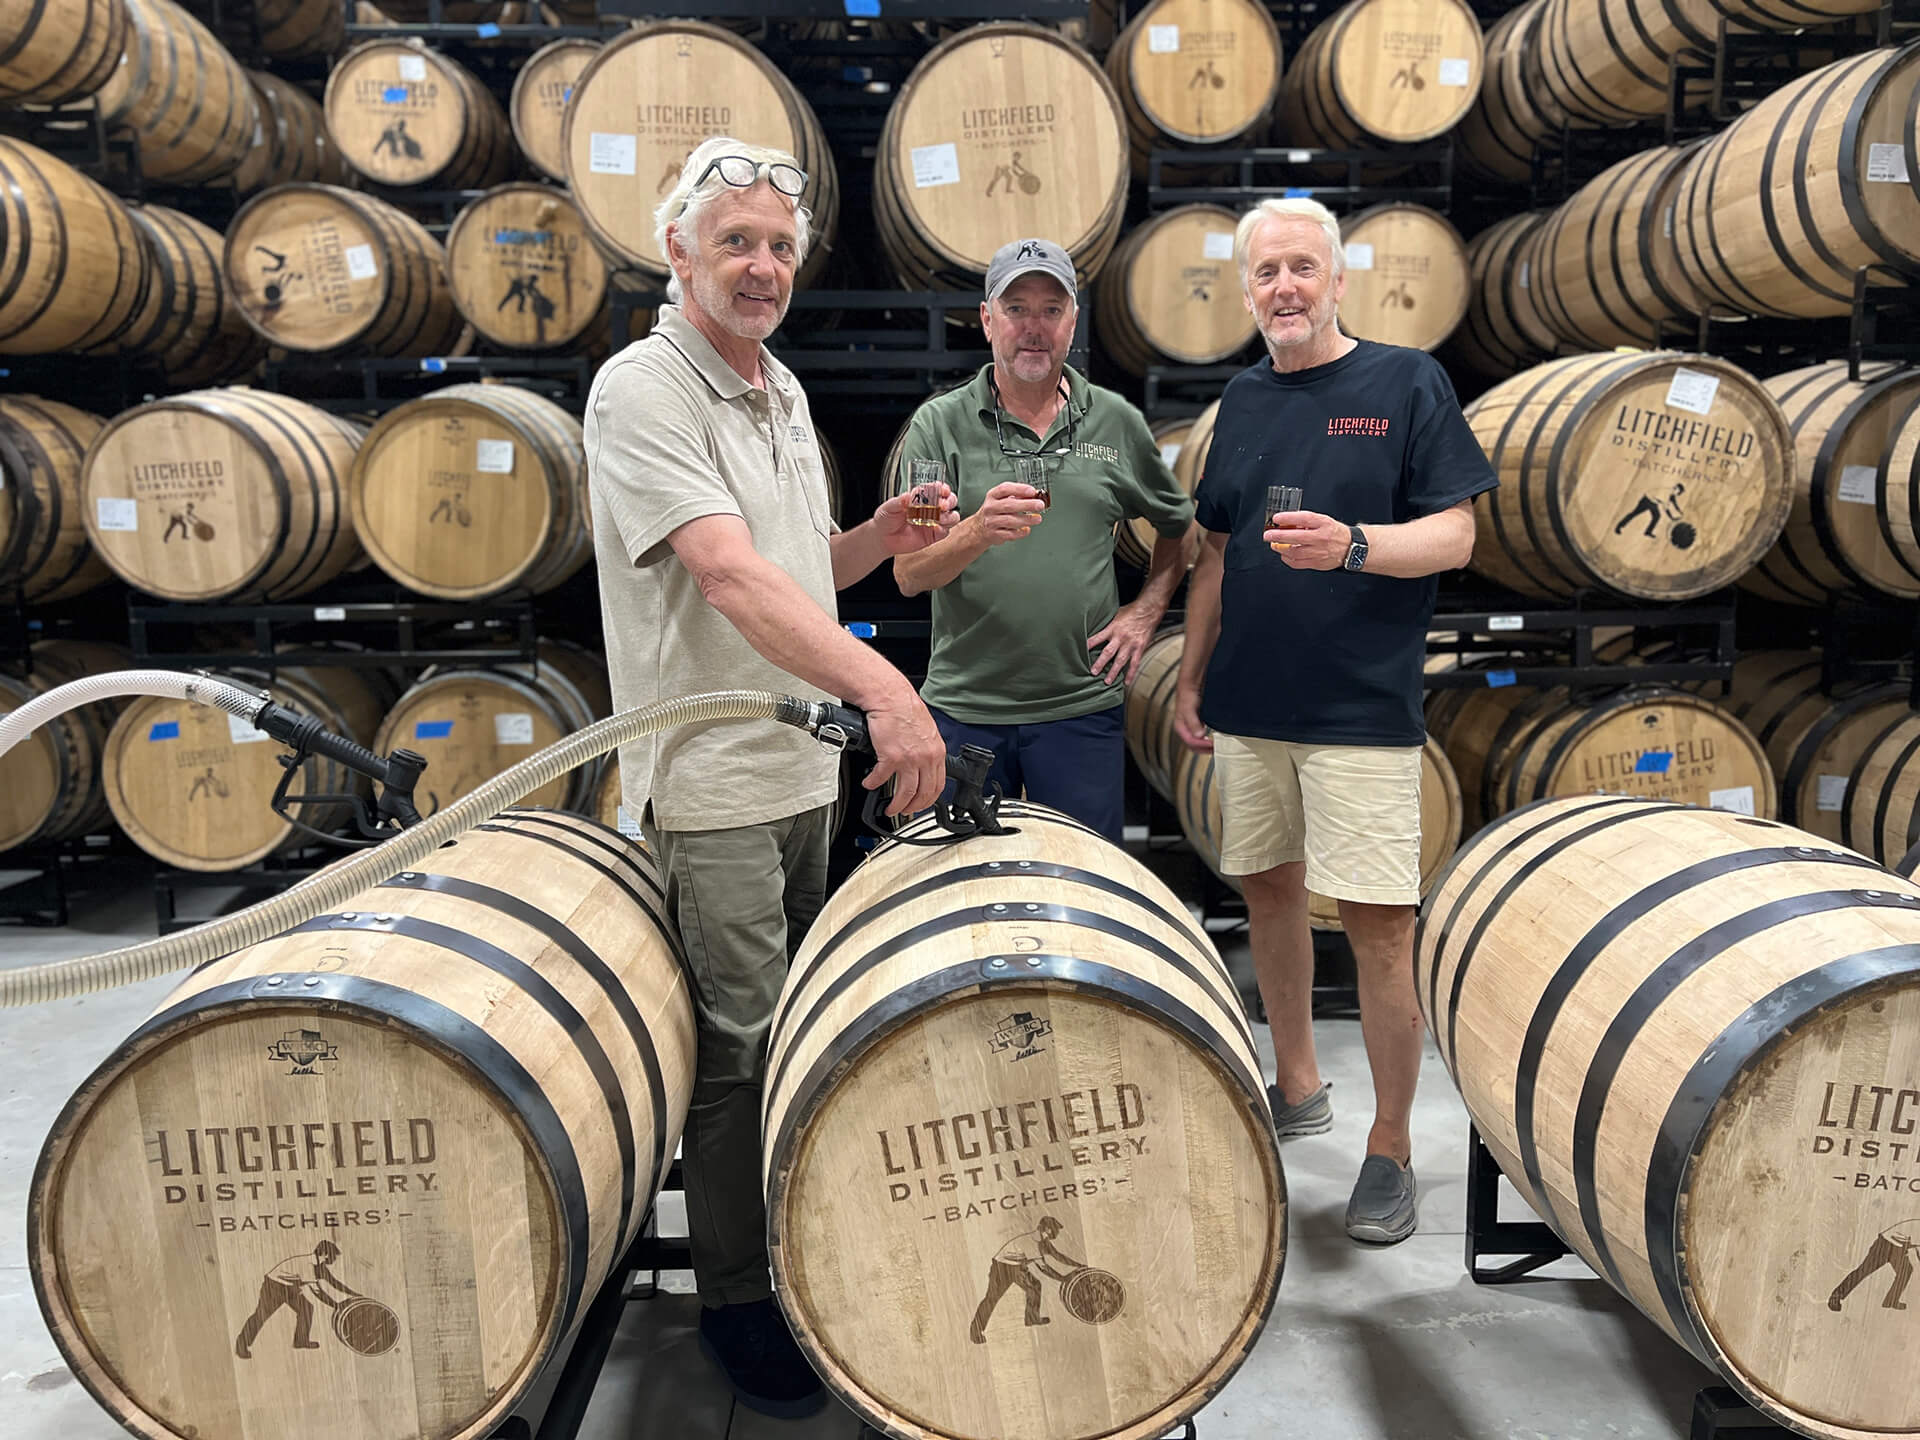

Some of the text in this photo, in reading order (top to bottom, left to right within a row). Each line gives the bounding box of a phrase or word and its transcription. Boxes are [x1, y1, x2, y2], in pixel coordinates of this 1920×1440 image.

[637, 104, 731, 125] LITCHFIELD
[962, 104, 1055, 129] LITCHFIELD
[1328, 418, 1389, 430] LITCHFIELD
[1616, 405, 1754, 458] LITCHFIELD
[1076, 440, 1118, 460] LITCHFIELD
[1611, 433, 1745, 473] DISTILLERY
[134, 461, 223, 481] LITCHFIELD
[877, 1083, 1146, 1177] LITCHFIELD
[157, 1118, 437, 1177] LITCHFIELD
[888, 1136, 1150, 1203] DISTILLERY
[164, 1173, 439, 1204] DISTILLERY
